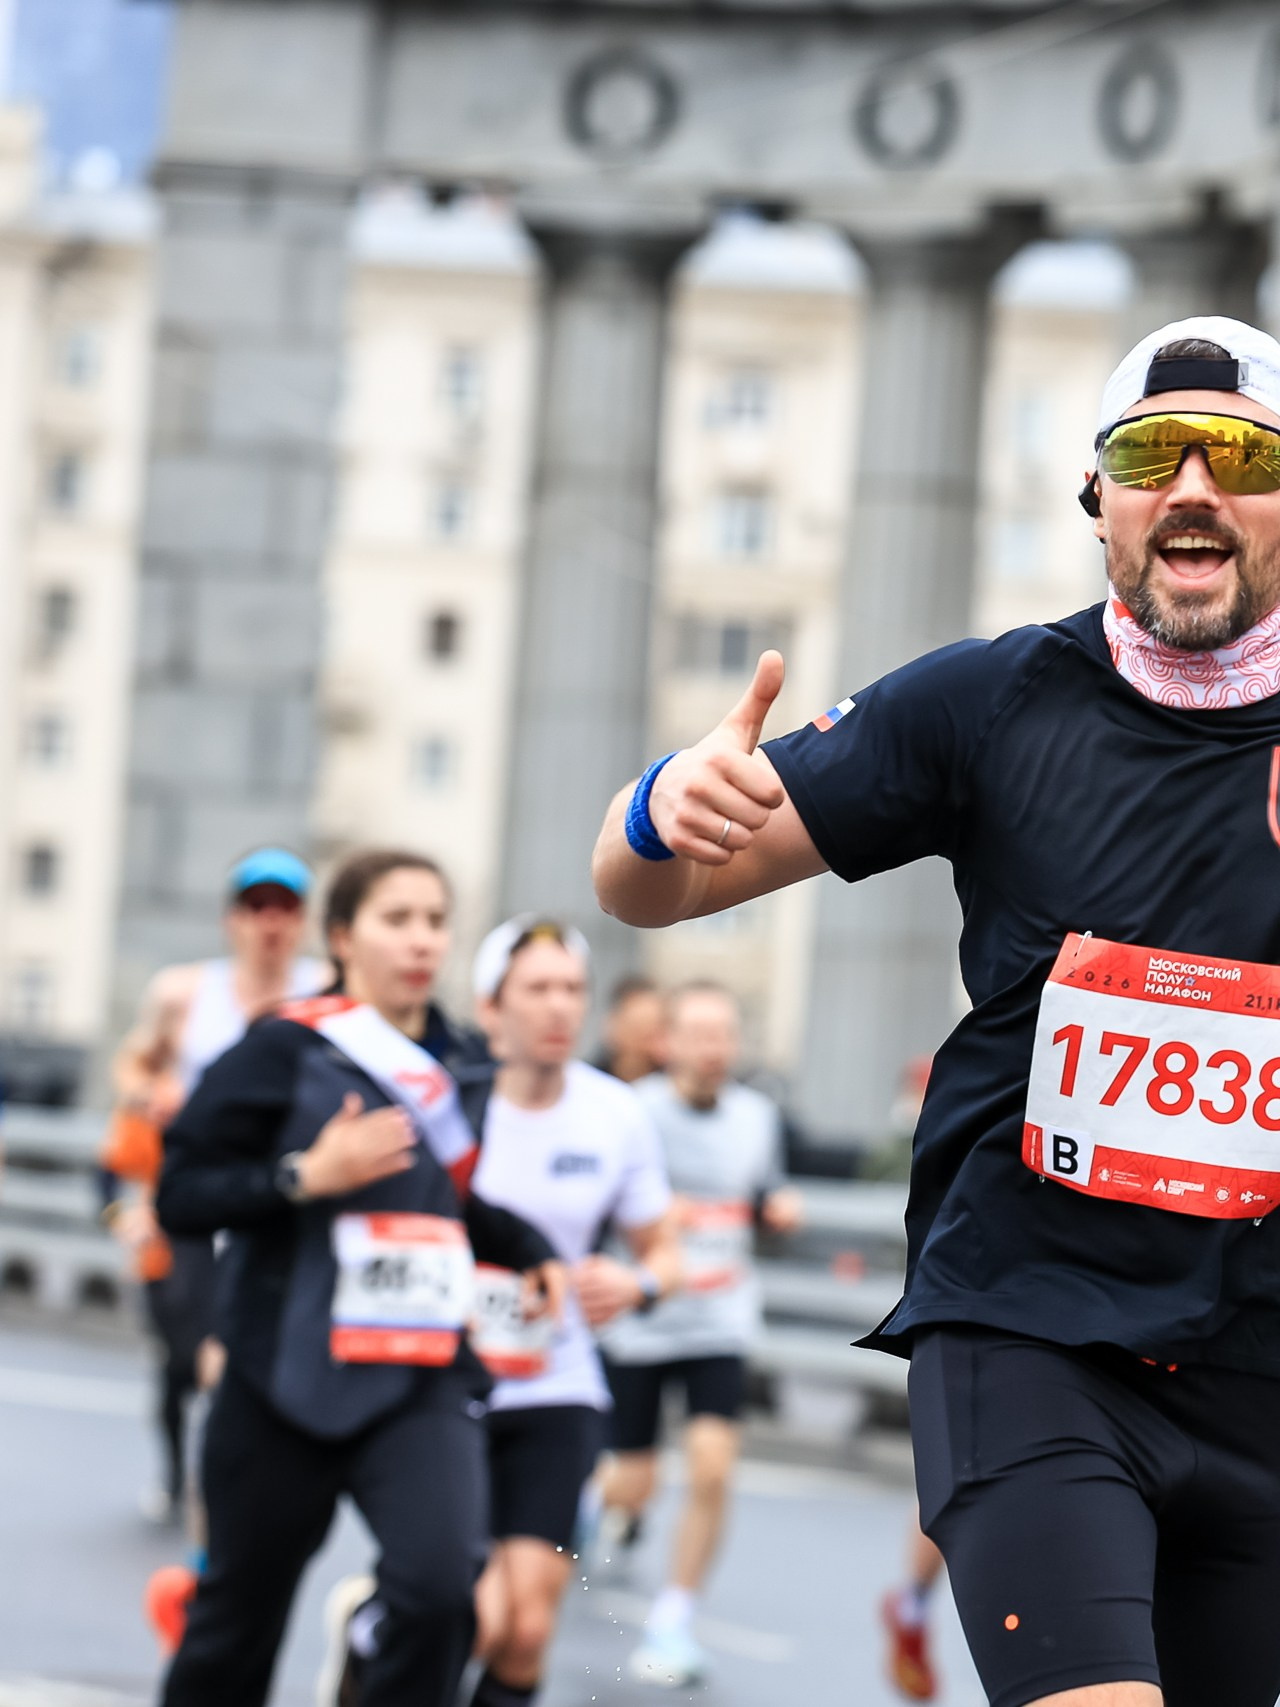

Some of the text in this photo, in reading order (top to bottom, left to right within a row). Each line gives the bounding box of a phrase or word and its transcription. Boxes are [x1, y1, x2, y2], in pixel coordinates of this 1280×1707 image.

[1146, 970, 1185, 986] ПОЛУ
[1148, 957, 1242, 982] МОСКОВСКИЙ
[1144, 983, 1212, 1002] МАРАФОН
[1052, 1134, 1079, 1175] B
